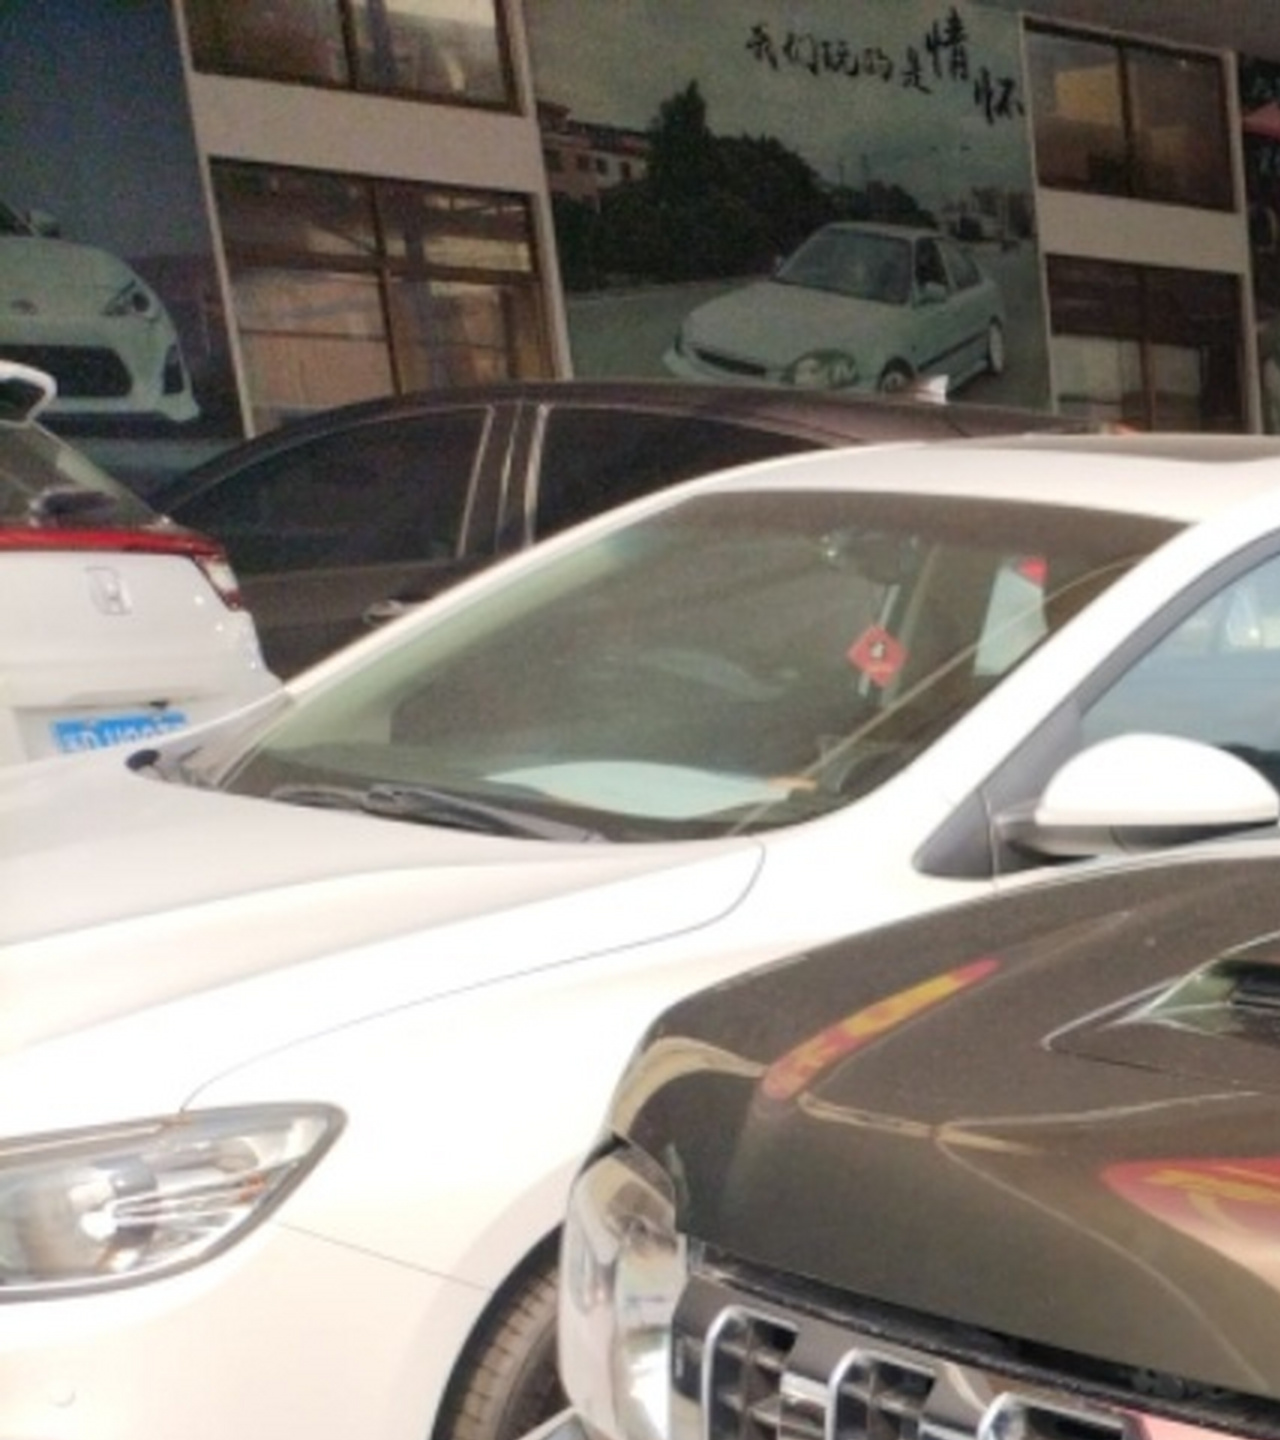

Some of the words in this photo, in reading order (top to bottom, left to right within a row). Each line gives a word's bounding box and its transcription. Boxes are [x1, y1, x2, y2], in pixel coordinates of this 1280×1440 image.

[746, 6, 1024, 125] 我们玩的是情怀
